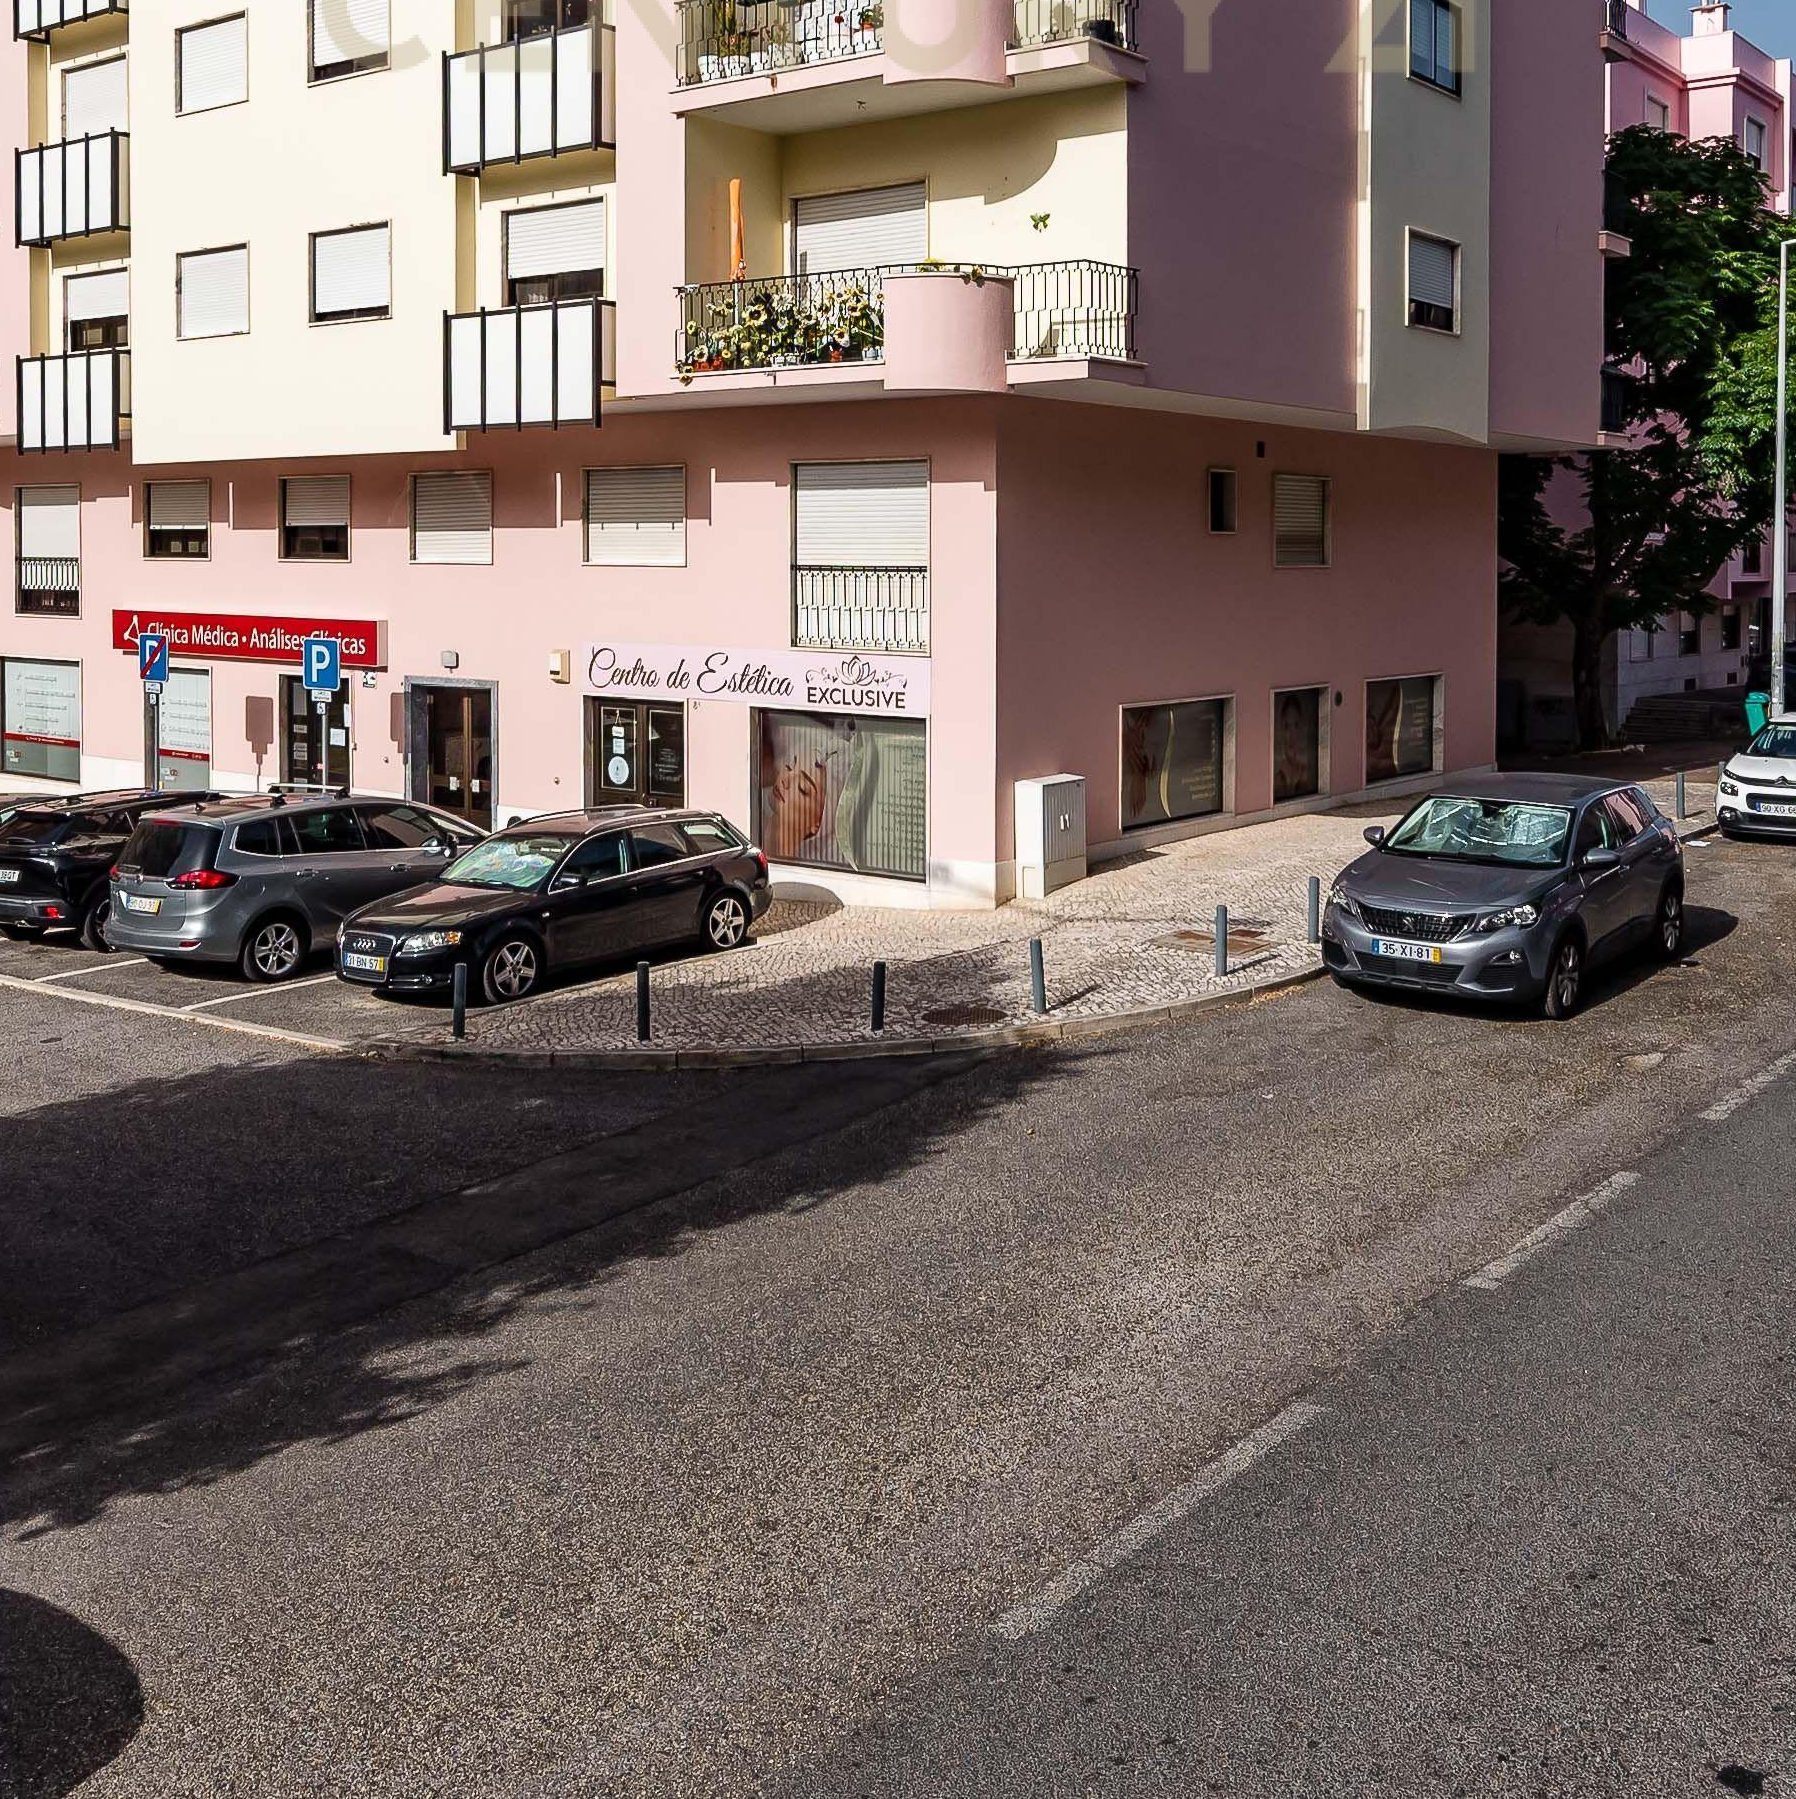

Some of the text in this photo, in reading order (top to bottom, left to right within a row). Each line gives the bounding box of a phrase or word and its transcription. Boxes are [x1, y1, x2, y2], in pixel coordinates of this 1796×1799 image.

[192, 624, 239, 647] Médica
[312, 645, 330, 682] P
[589, 646, 794, 696] Centro de Estética
[807, 686, 906, 709] EXCLUSIVE
